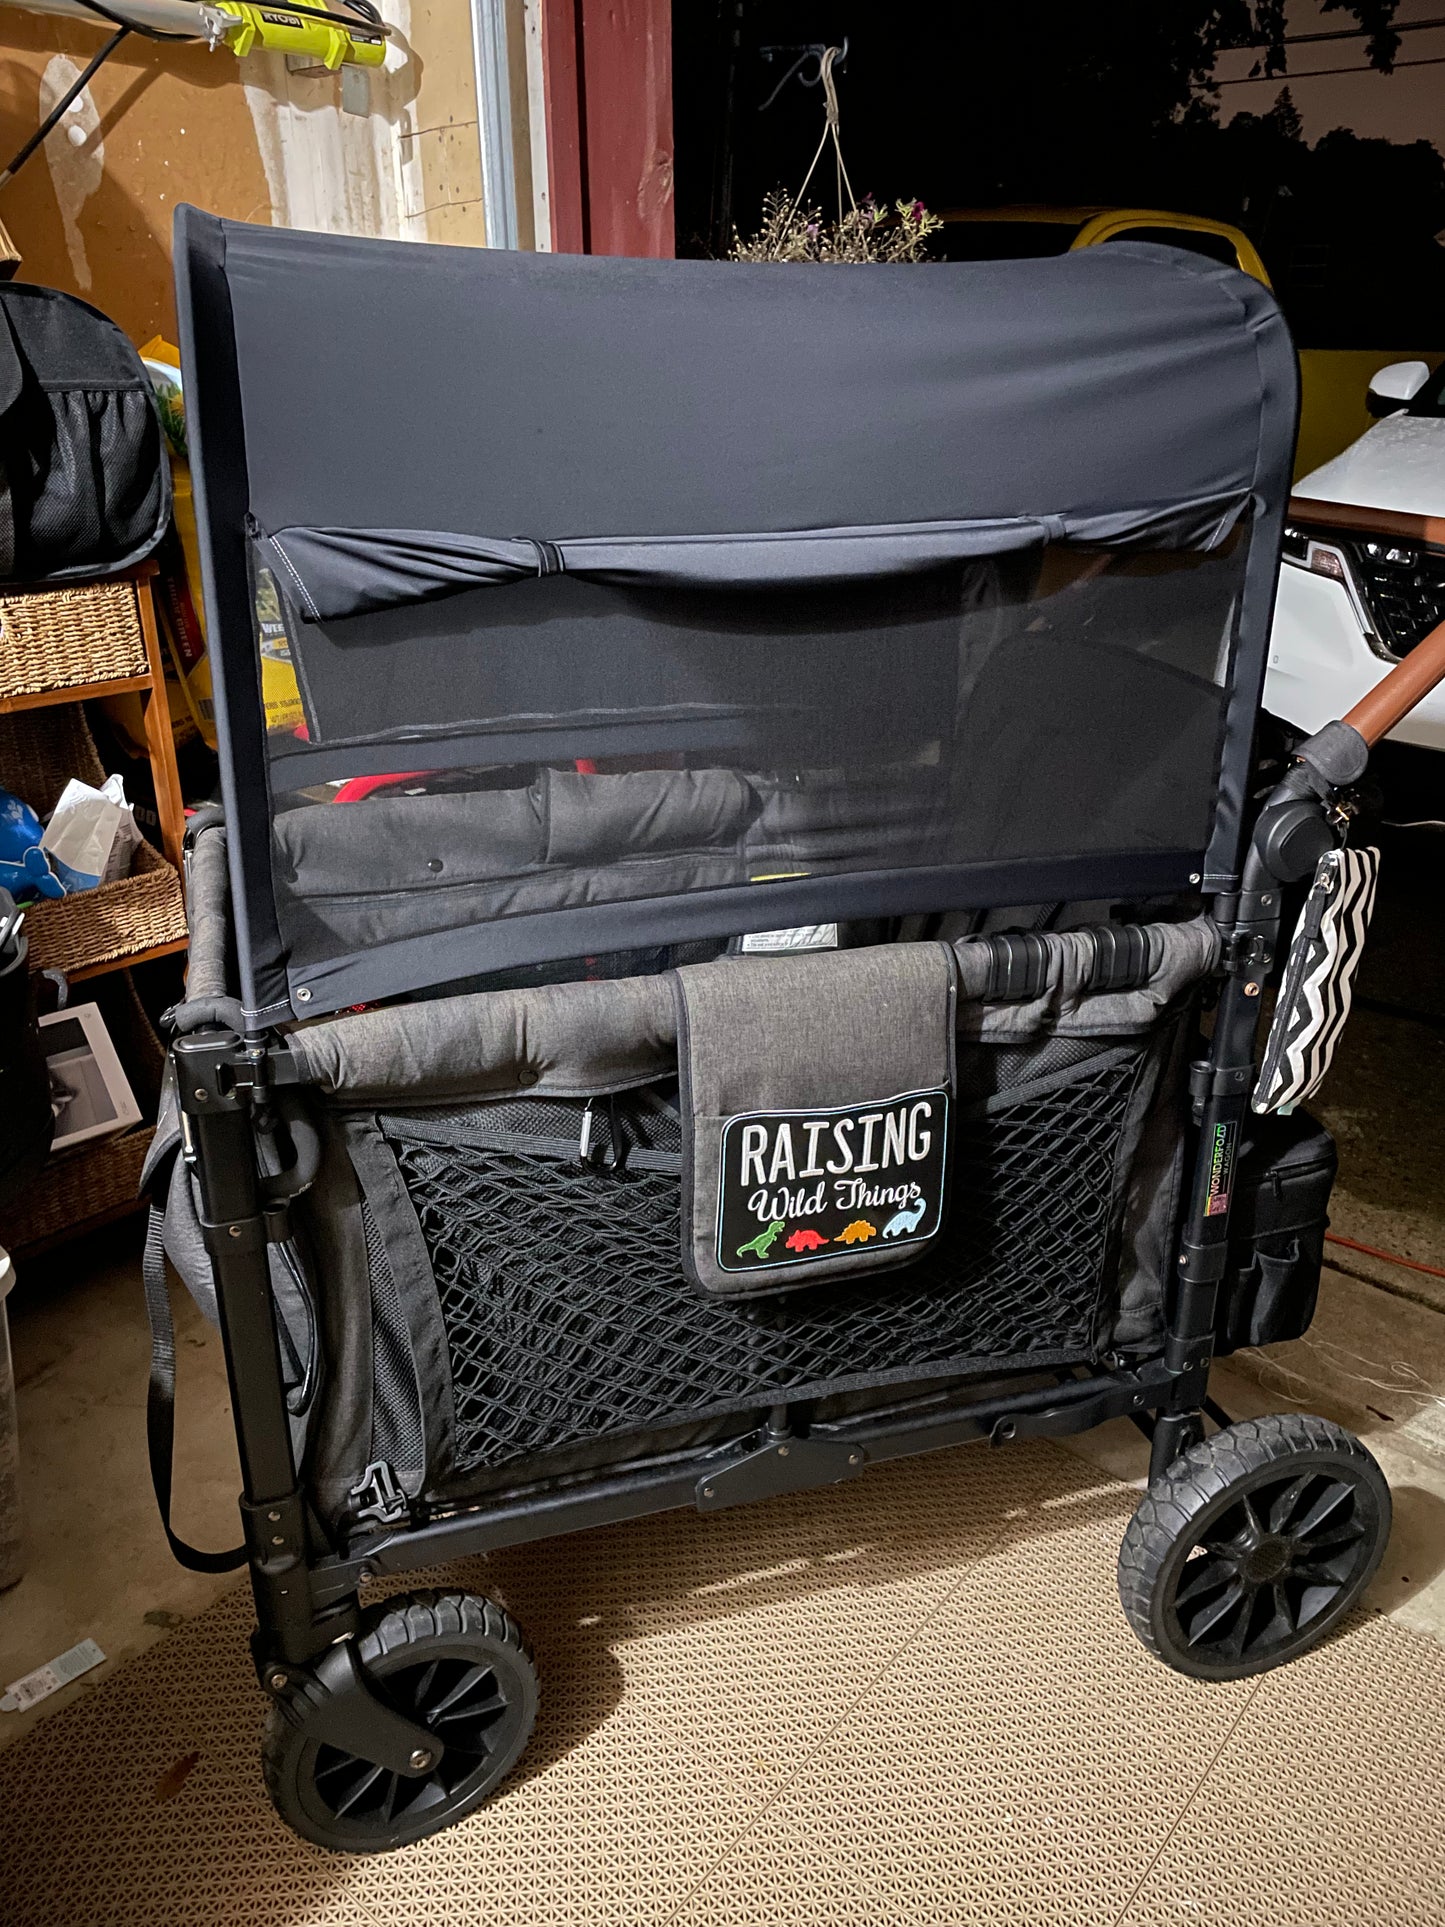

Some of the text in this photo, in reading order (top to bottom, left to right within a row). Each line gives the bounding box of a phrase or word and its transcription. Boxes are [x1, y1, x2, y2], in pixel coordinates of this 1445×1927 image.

[262, 11, 301, 26] RYOBI
[740, 1101, 932, 1187] RAISING
[1222, 1142, 1233, 1176] WAGON
[747, 1177, 922, 1222] Wild Things
